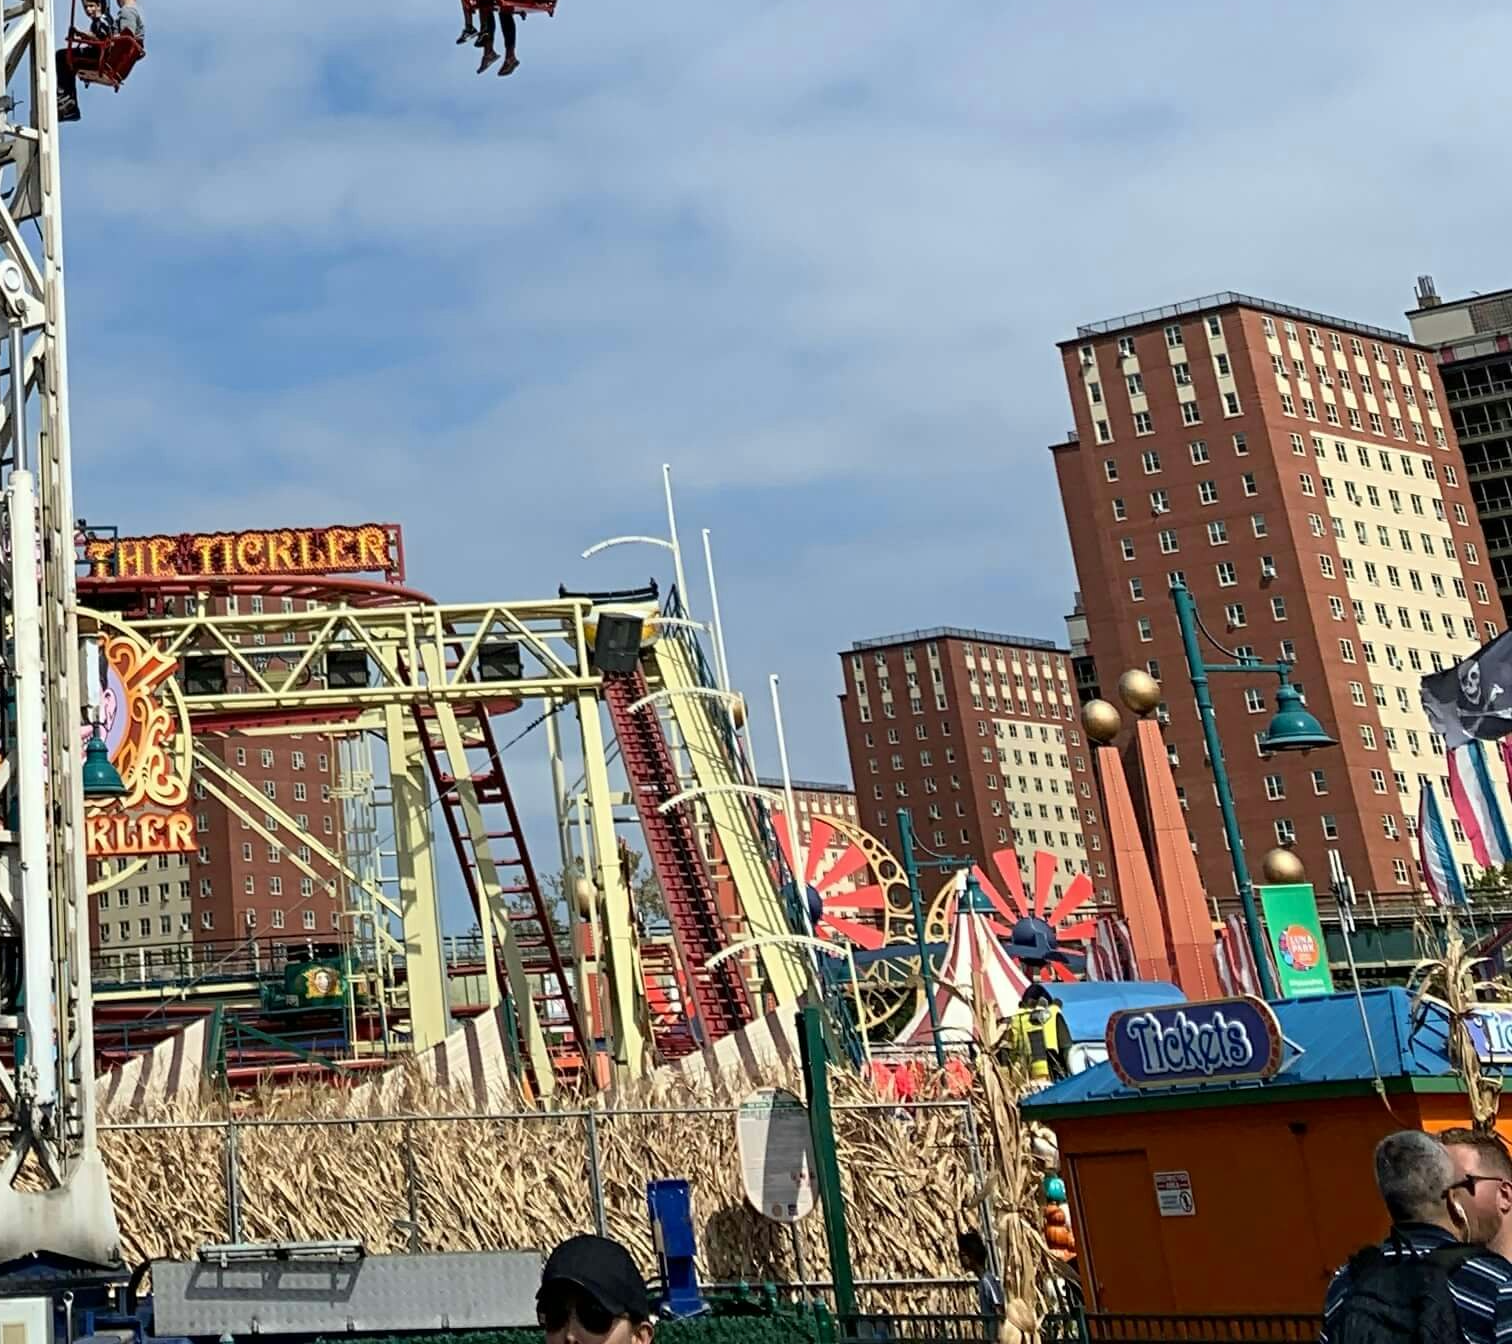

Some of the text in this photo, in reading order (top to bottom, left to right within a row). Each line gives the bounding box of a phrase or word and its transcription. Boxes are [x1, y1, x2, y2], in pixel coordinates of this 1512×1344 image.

[87, 526, 391, 577] THE TICKLER
[85, 811, 198, 853] KLER
[1126, 1011, 1254, 1075] Tickets
